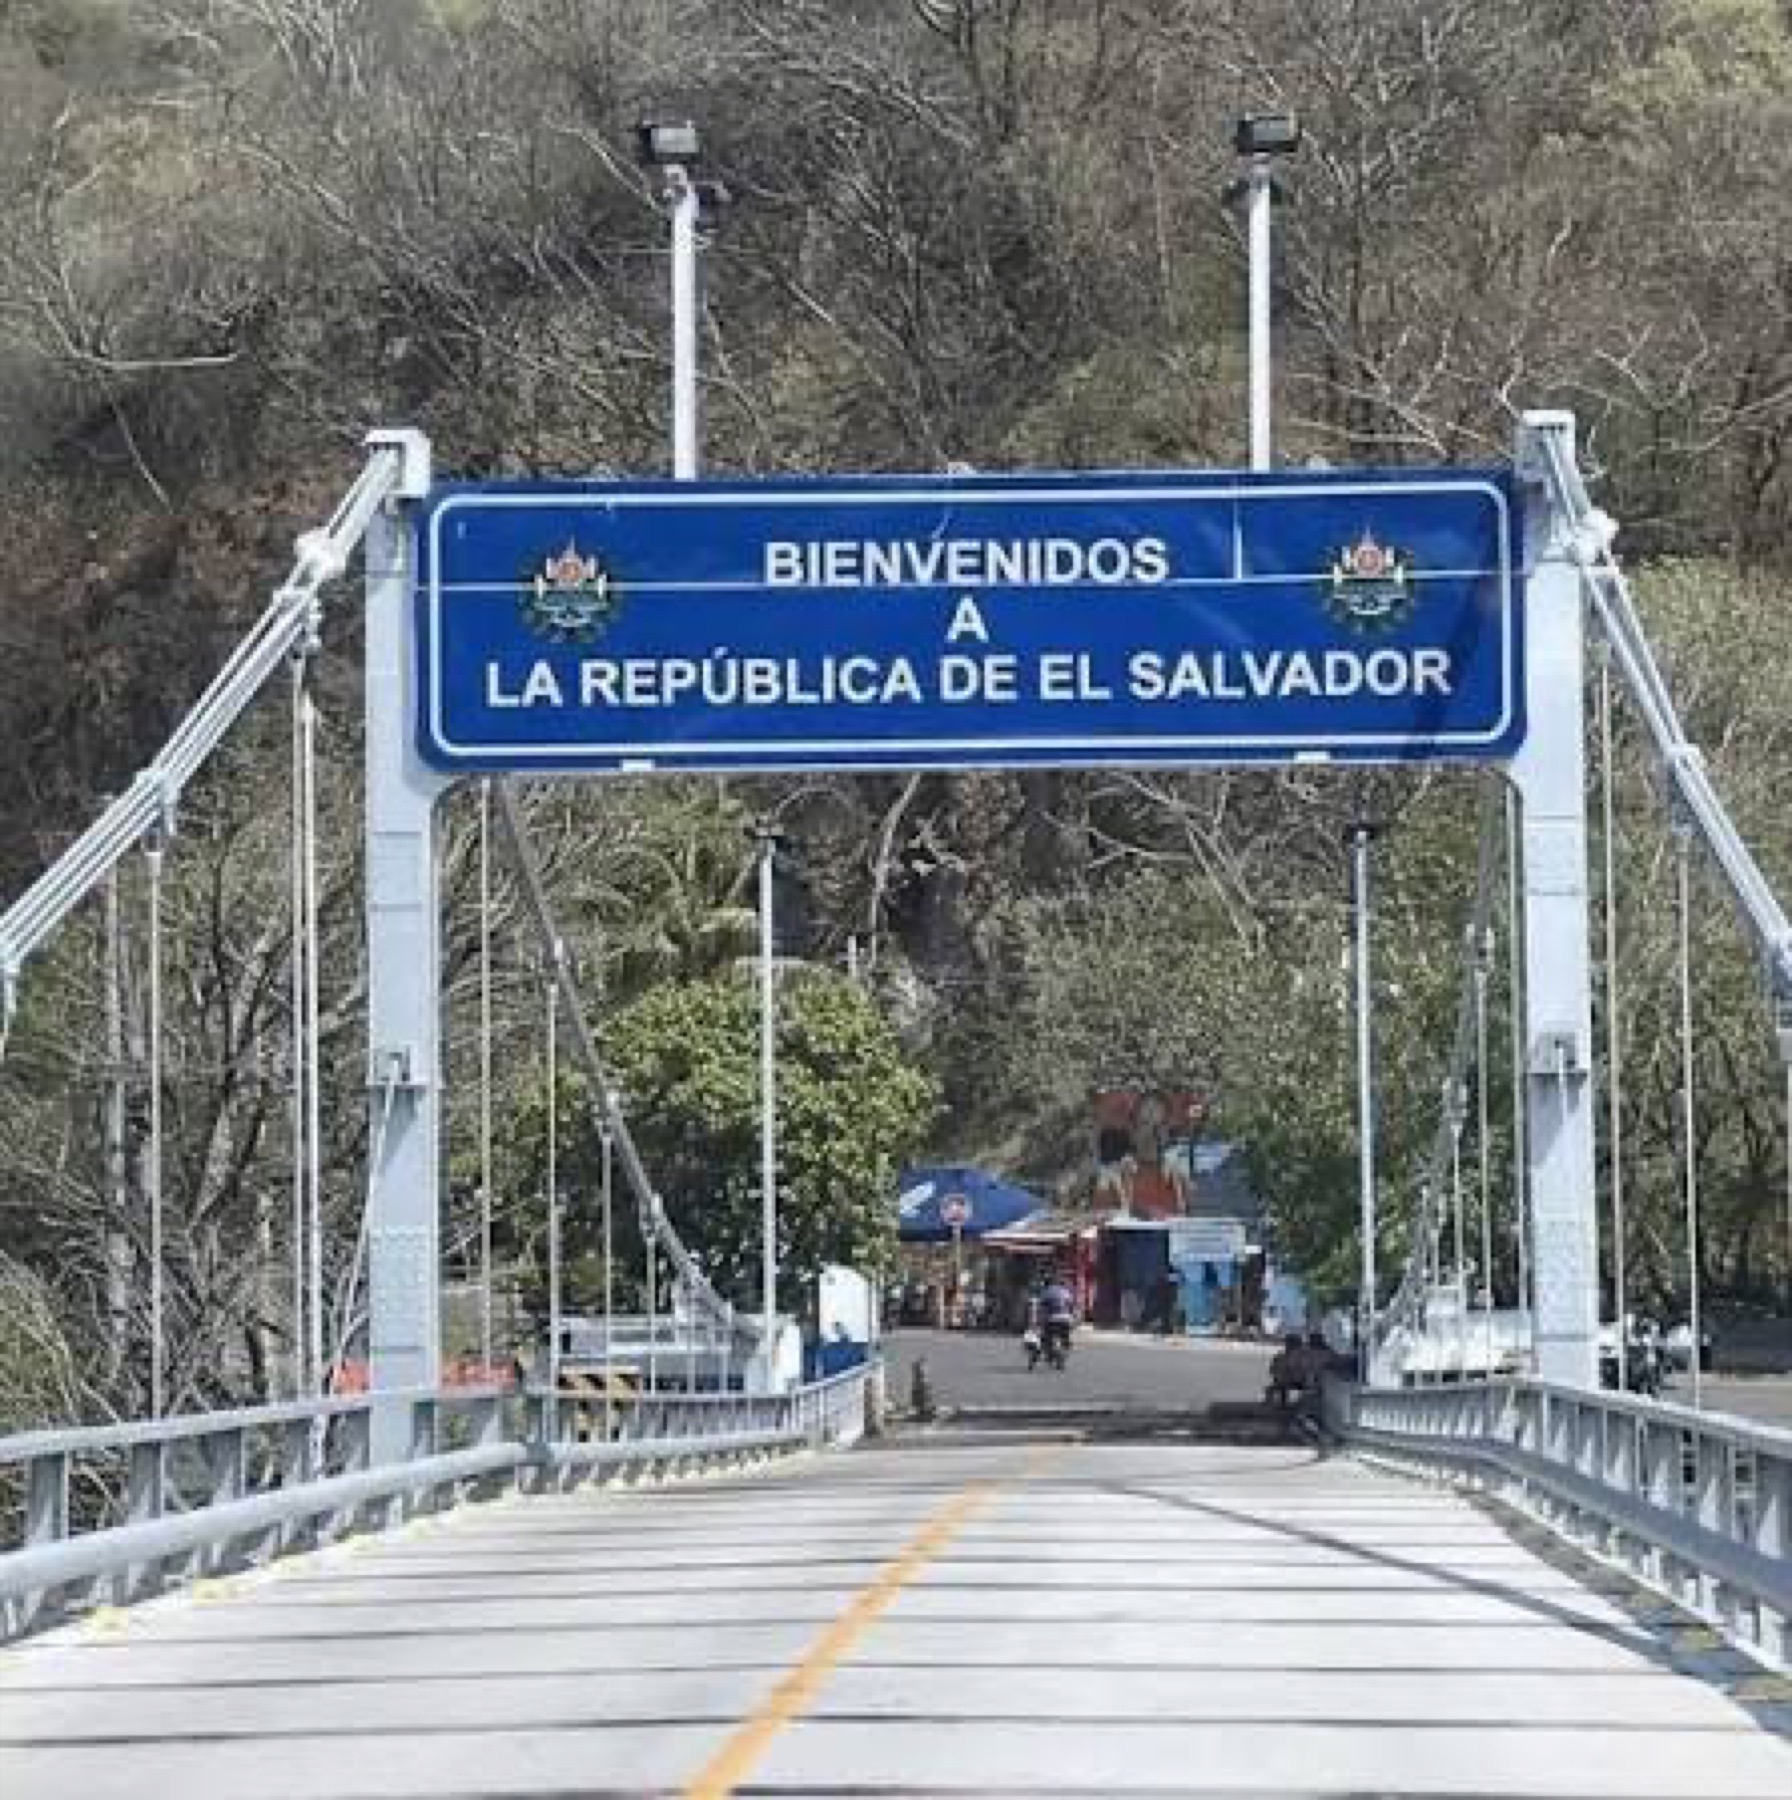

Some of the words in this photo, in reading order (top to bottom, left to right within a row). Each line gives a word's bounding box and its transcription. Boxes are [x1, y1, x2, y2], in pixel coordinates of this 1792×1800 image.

[765, 538, 1170, 587] BIENVENIDOS
[947, 596, 989, 643] A
[488, 662, 563, 707] LA
[581, 647, 921, 705] REPÚBLICA
[939, 655, 1018, 701] DE
[1040, 654, 1111, 700] EL
[1129, 650, 1453, 700] SALVADOR
